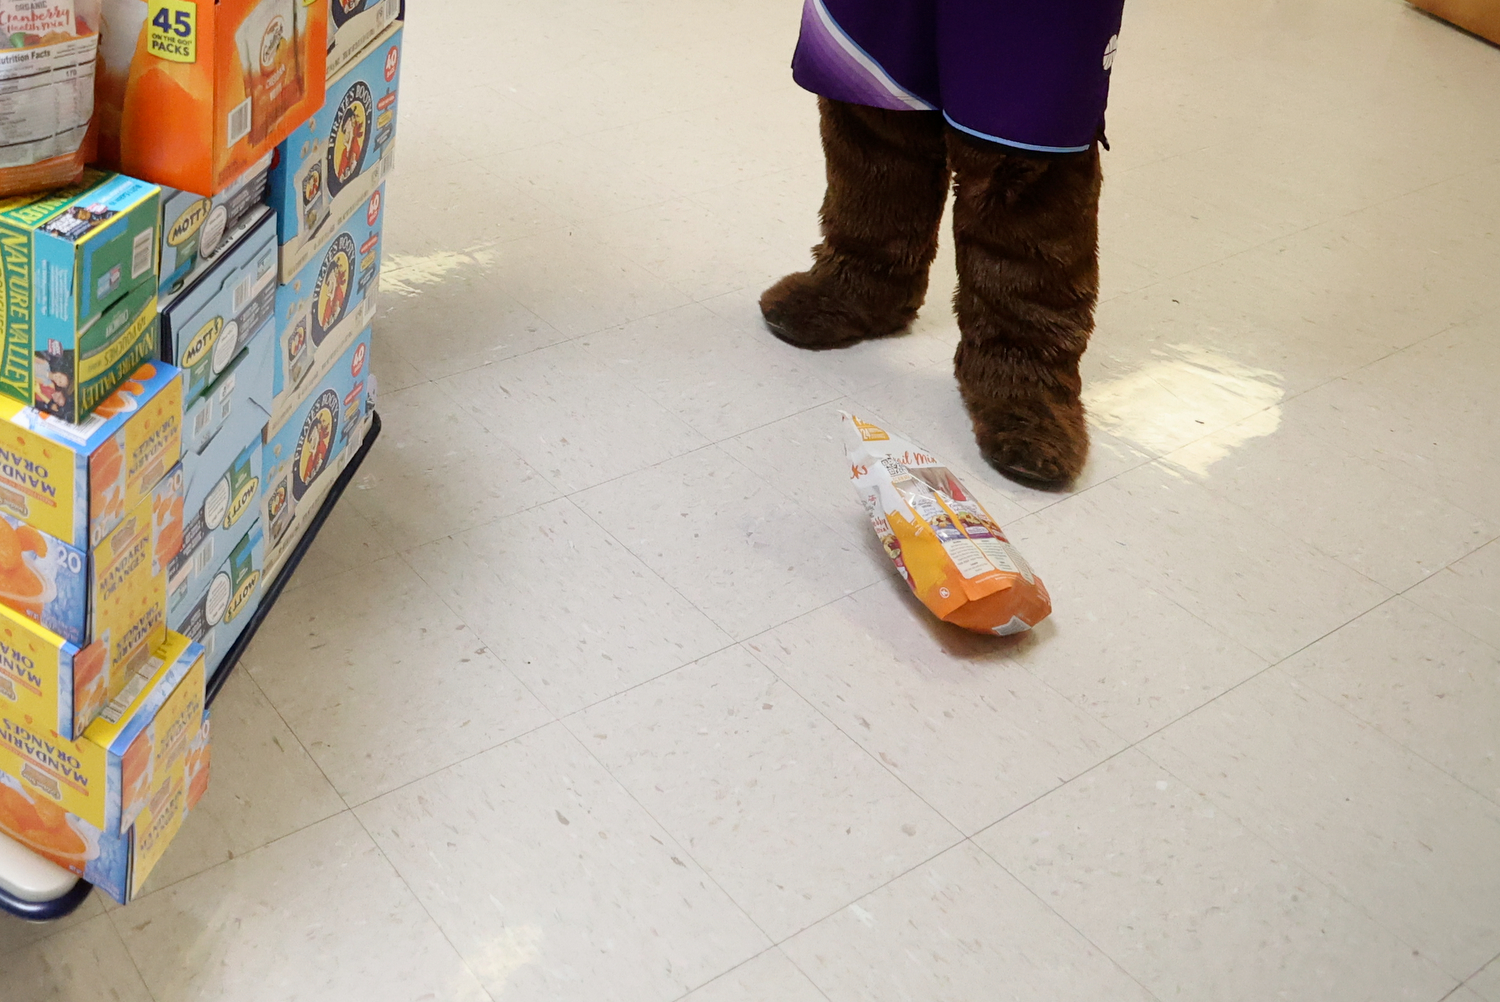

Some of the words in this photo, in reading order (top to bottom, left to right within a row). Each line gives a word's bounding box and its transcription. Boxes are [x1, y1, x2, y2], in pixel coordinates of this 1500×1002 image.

[152, 6, 192, 38] 45
[163, 35, 175, 43] THE
[31, 49, 51, 62] Facts
[151, 40, 190, 57] PACKS
[386, 49, 398, 71] 40
[329, 88, 356, 149] PIRATE'S
[356, 84, 373, 117] BOOTY
[172, 199, 209, 242] MOTT'S
[369, 194, 380, 214] 40
[338, 235, 356, 266] BOOTY
[184, 318, 221, 364] MOTT'S
[353, 345, 365, 368] 40
[0, 323, 28, 398] VALLEY
[132, 415, 175, 462] ORANGES
[294, 398, 322, 461] PIRATE'S
[321, 393, 340, 417] BOOTY
[859, 427, 871, 440] 24
[128, 424, 179, 479] MANDARIN
[912, 451, 938, 466] Mix
[166, 468, 183, 490] 20
[227, 479, 258, 527] MOTT'S
[55, 545, 82, 574] 20
[100, 534, 150, 592] MANDARIN
[103, 550, 147, 602] ORANGES
[227, 573, 258, 620] MOTT'S
[2, 717, 82, 770] ORANGES
